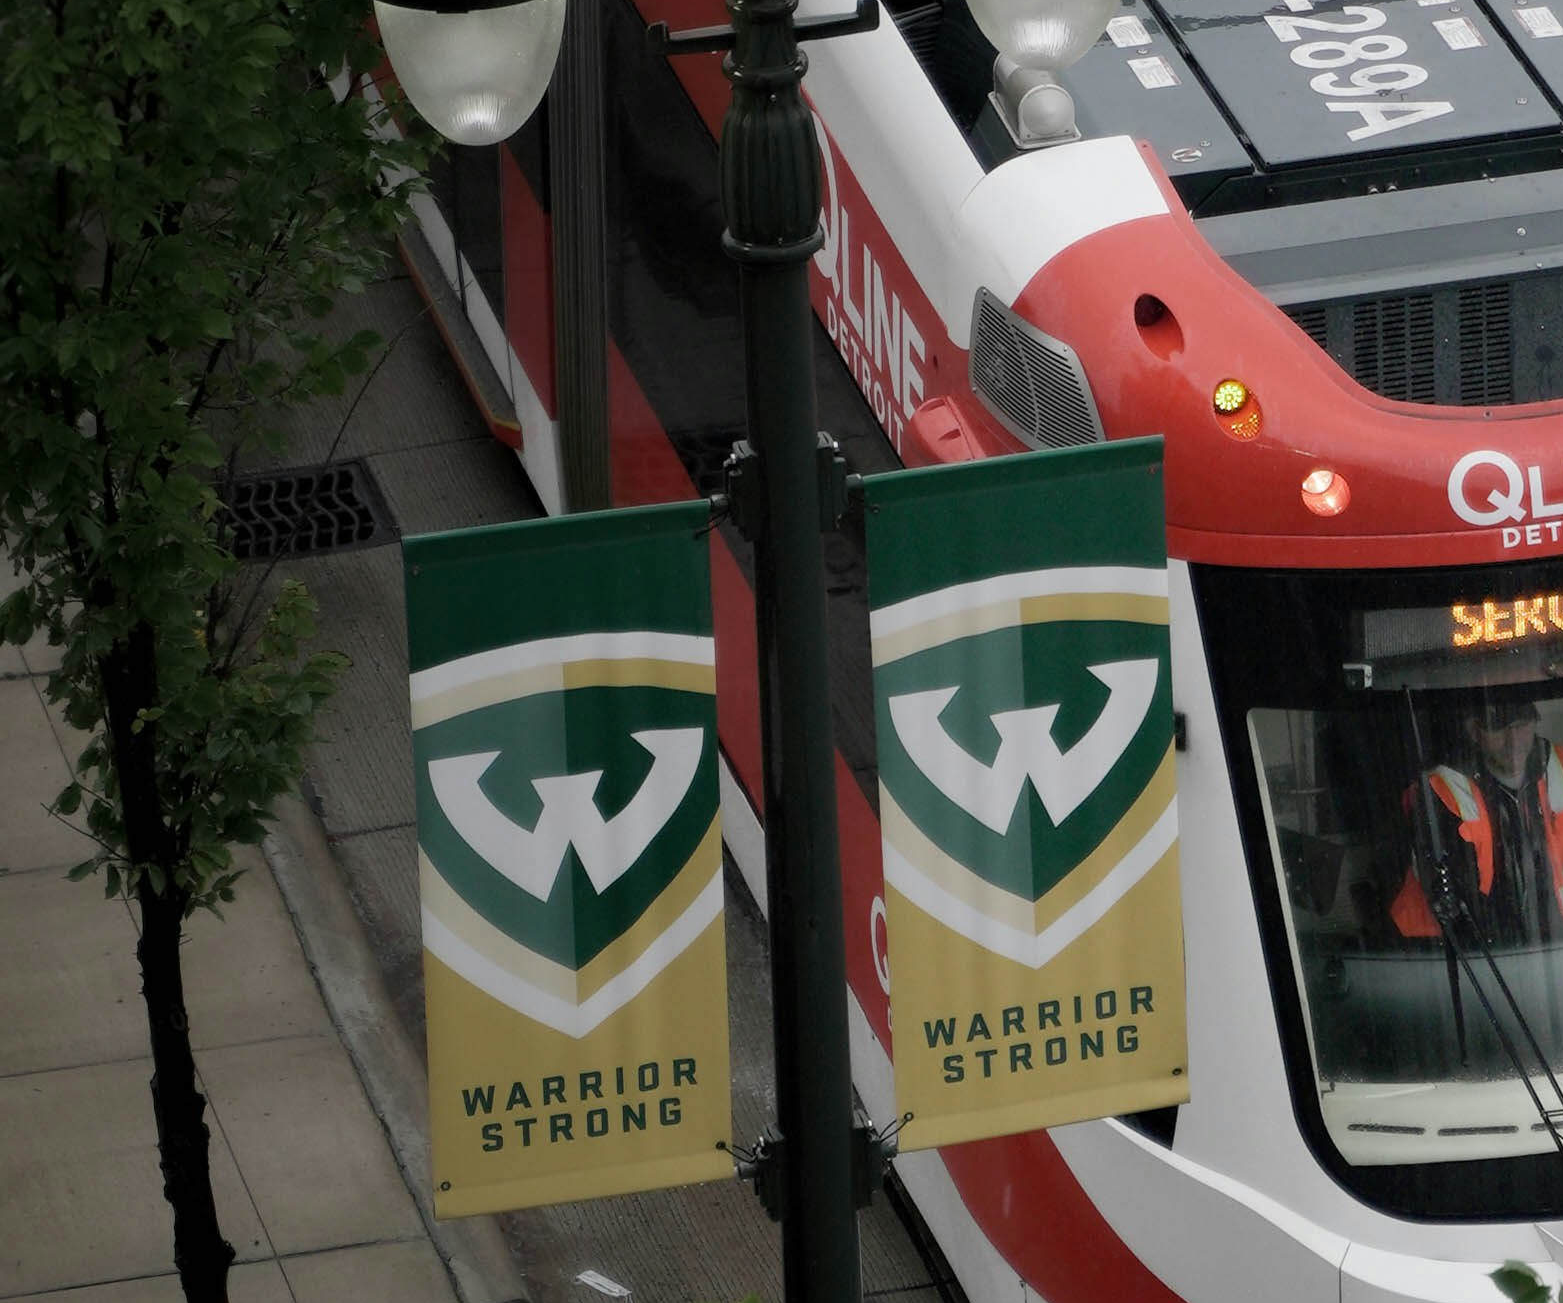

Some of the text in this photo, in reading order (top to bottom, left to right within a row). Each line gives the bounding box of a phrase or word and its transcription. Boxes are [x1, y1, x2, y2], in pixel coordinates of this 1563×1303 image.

[826, 296, 904, 457] DETROIT
[923, 985, 1155, 1049] WARRIOR
[943, 1024, 1139, 1084] STRONG
[460, 1057, 699, 1118] WARRIOR
[480, 1096, 683, 1153] STRONG
